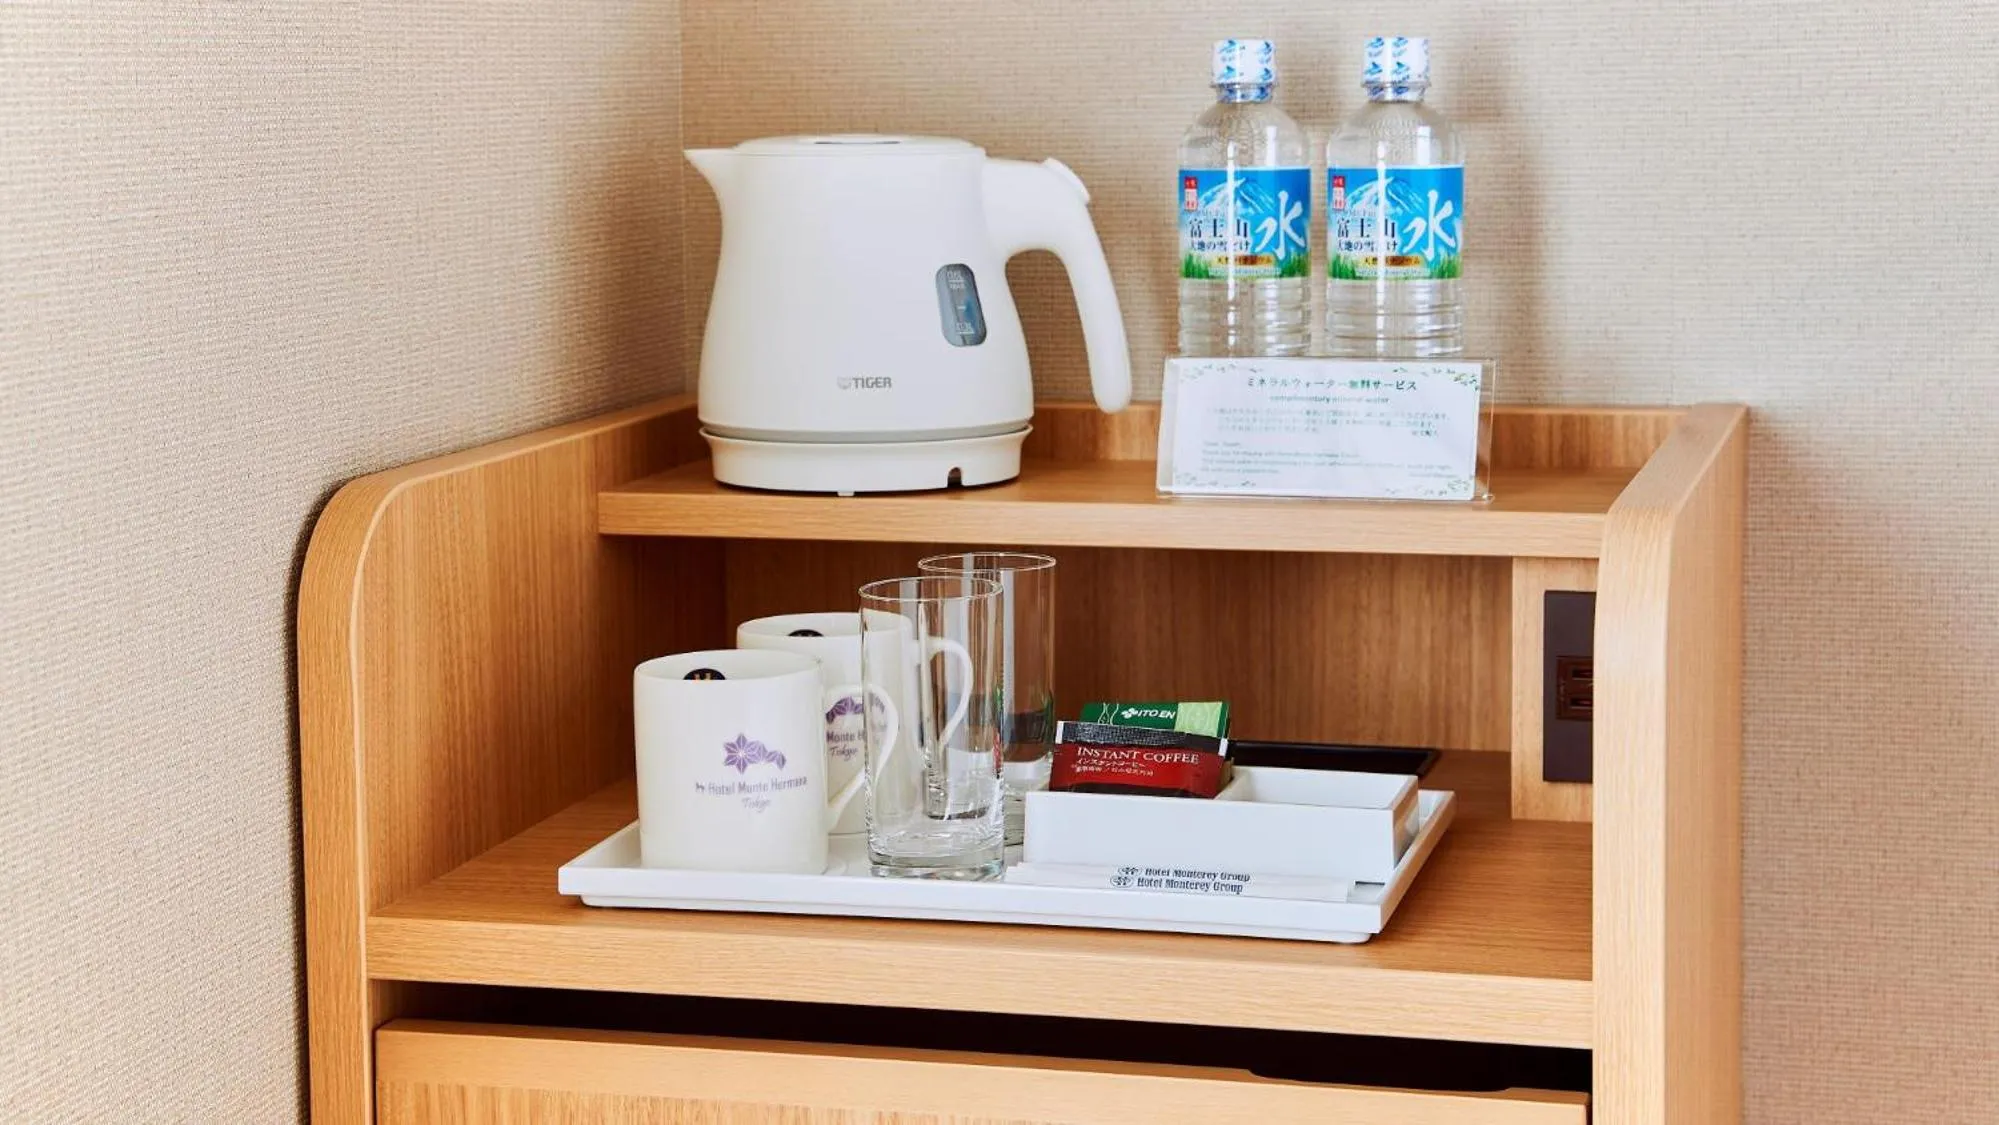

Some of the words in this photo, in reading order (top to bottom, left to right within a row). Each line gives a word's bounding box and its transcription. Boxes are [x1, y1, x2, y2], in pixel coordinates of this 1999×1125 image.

[1255, 190, 1306, 261] 水
[1403, 189, 1456, 262] 水
[852, 376, 893, 389] TIGER
[826, 730, 855, 743] Monte
[1077, 746, 1141, 760] INSTANT
[1143, 752, 1201, 765] COFFEE
[708, 783, 735, 797] Hotel
[738, 781, 769, 794] Monte
[1145, 868, 1170, 877] Hotel
[1173, 869, 1218, 881] Monterey
[1220, 872, 1251, 882] Group
[1137, 877, 1163, 888] Hotel
[1165, 879, 1211, 892] Monterey
[1213, 881, 1243, 895] Group
